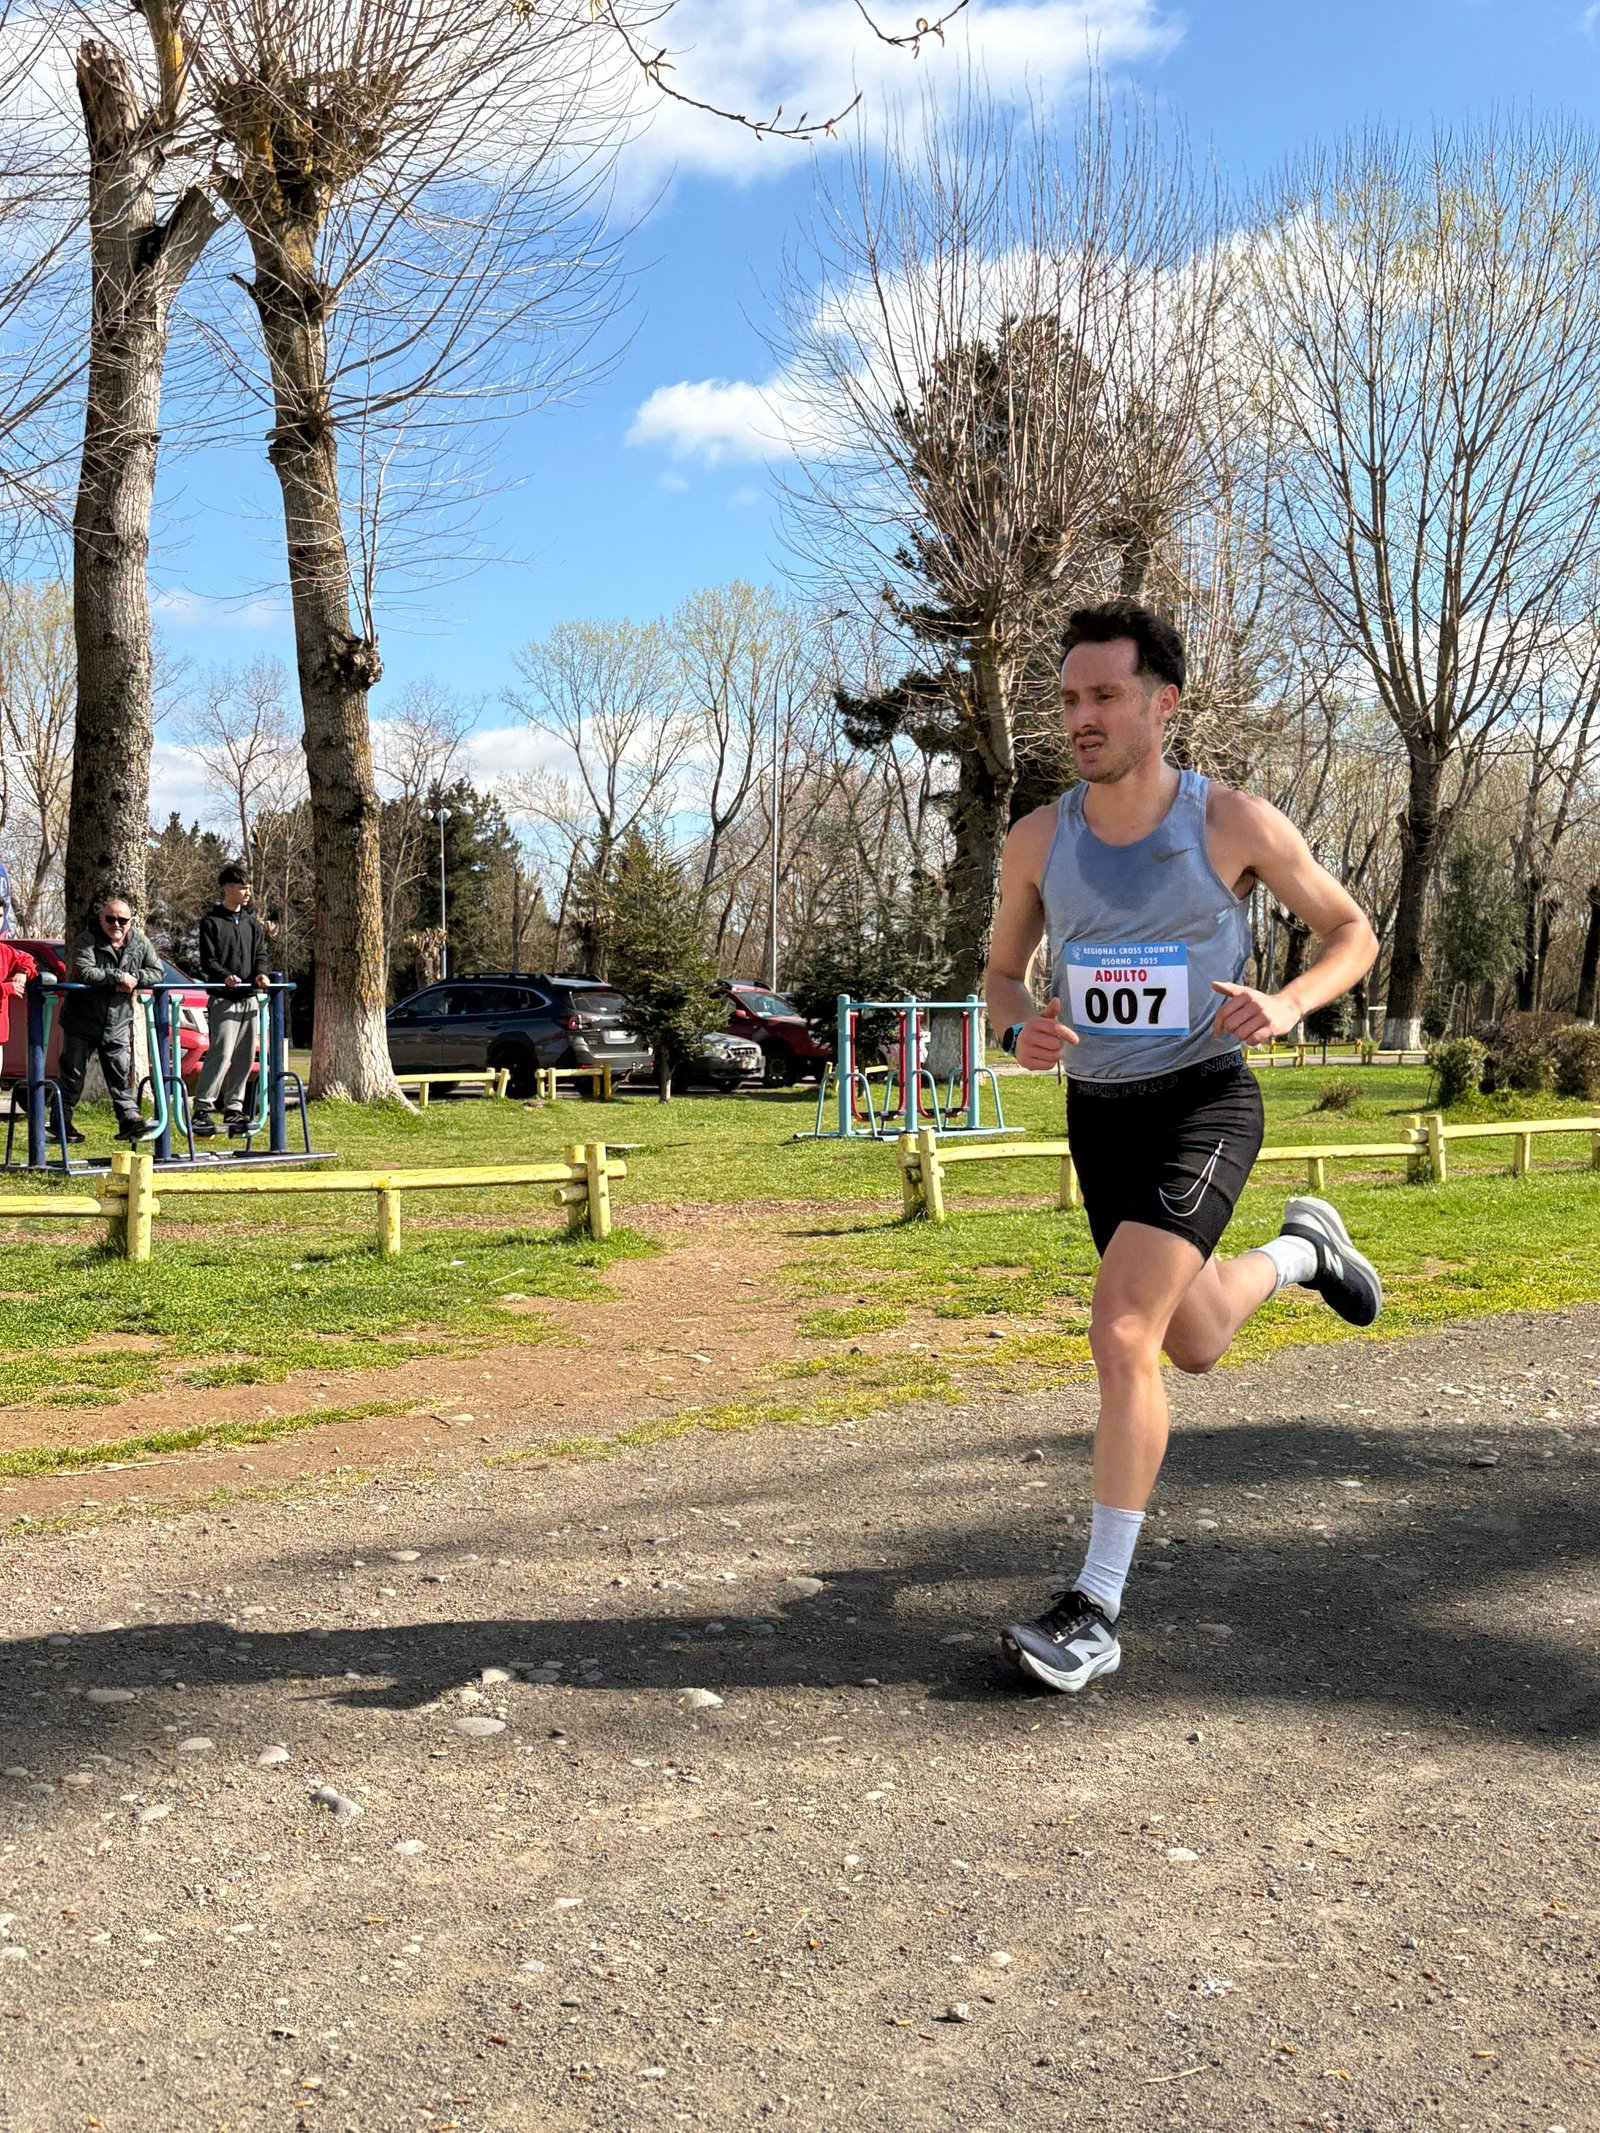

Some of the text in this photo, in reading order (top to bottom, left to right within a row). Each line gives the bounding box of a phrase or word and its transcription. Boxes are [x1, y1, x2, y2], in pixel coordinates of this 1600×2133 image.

[1083, 945, 1179, 955] REGIONAL CROSS COUNTRY
[1140, 957, 1158, 965] 2025
[1095, 969, 1148, 983] ADULTO
[1085, 987, 1167, 1025] 007
[1077, 1081, 1119, 1098] NIKE
